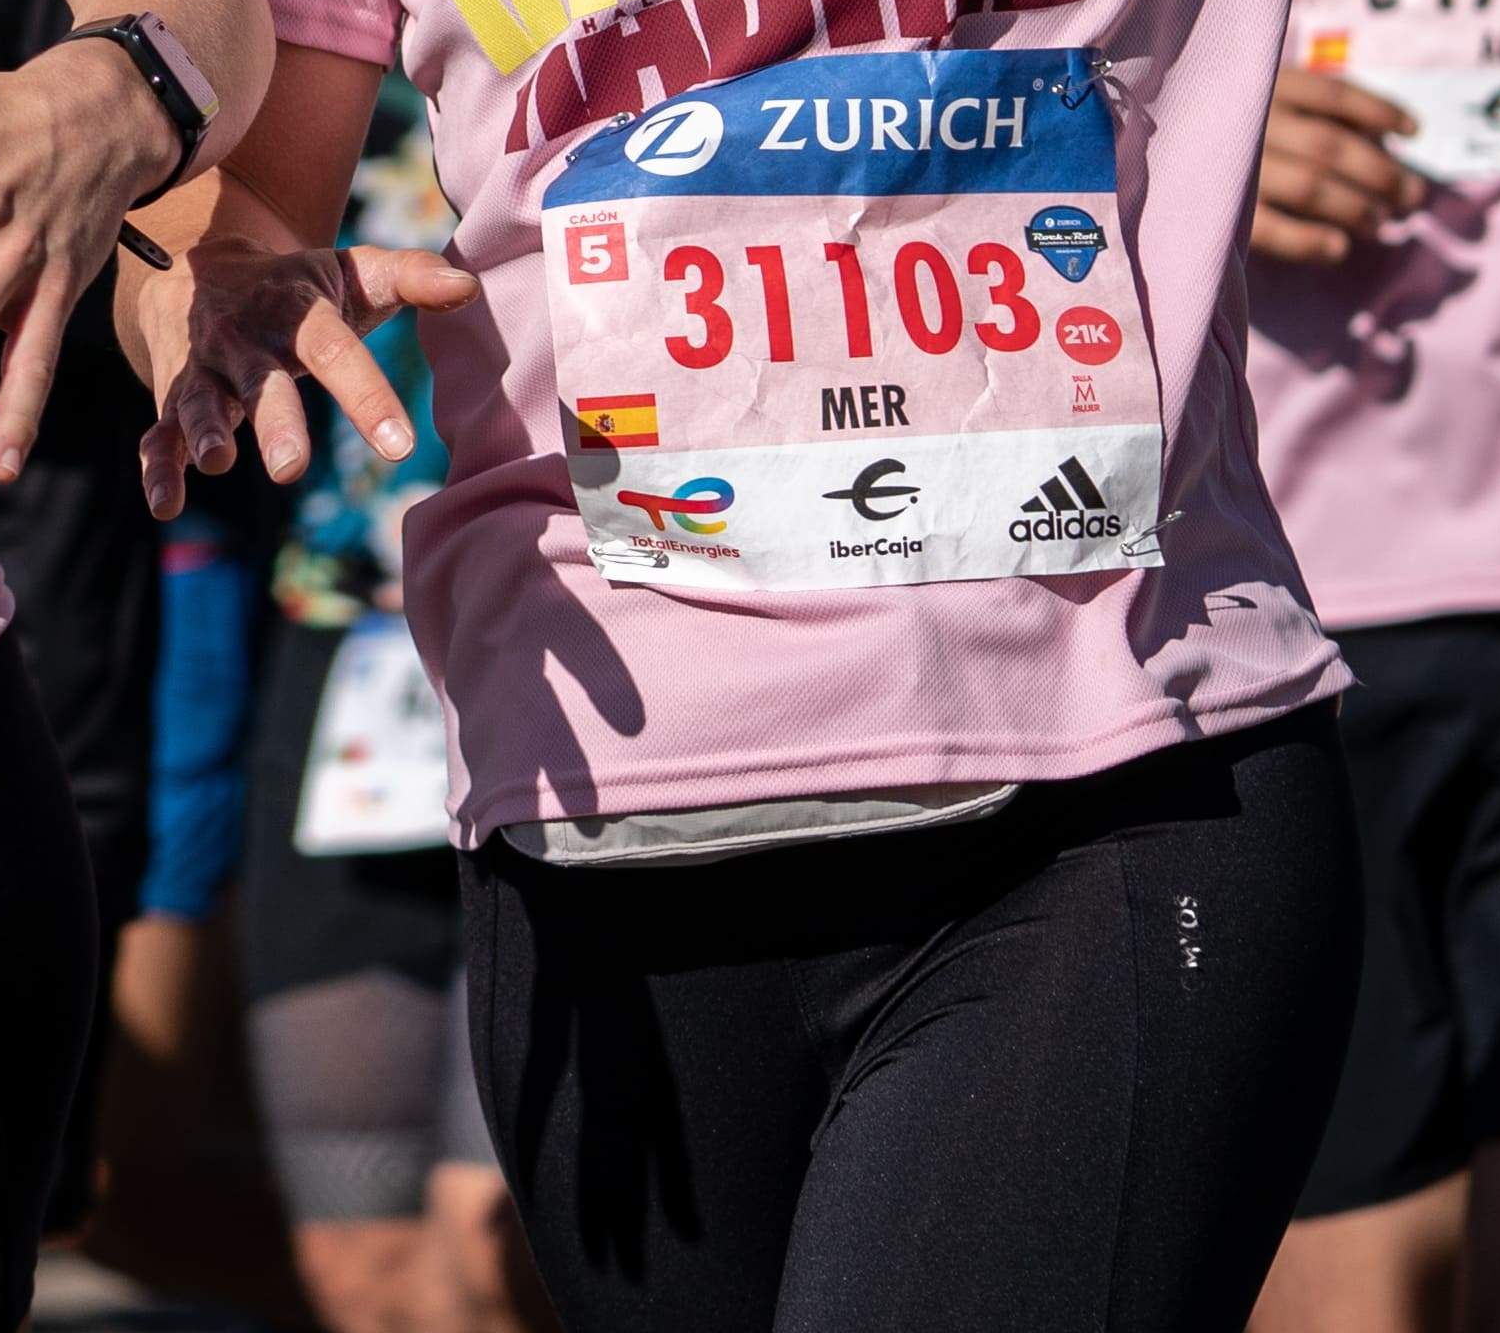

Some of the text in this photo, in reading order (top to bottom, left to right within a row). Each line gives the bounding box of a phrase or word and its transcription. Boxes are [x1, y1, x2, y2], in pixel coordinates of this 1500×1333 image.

[759, 95, 1025, 152] ZURICH
[568, 209, 618, 225] CAJÓN
[579, 233, 613, 275] 5
[661, 240, 1041, 371] 31103
[1063, 323, 1111, 345] 21K
[820, 384, 910, 432] MER
[1075, 383, 1096, 403] M
[1008, 508, 1121, 543] adidas
[629, 534, 741, 560] TotalEnergies
[829, 536, 924, 560] iberCaja
